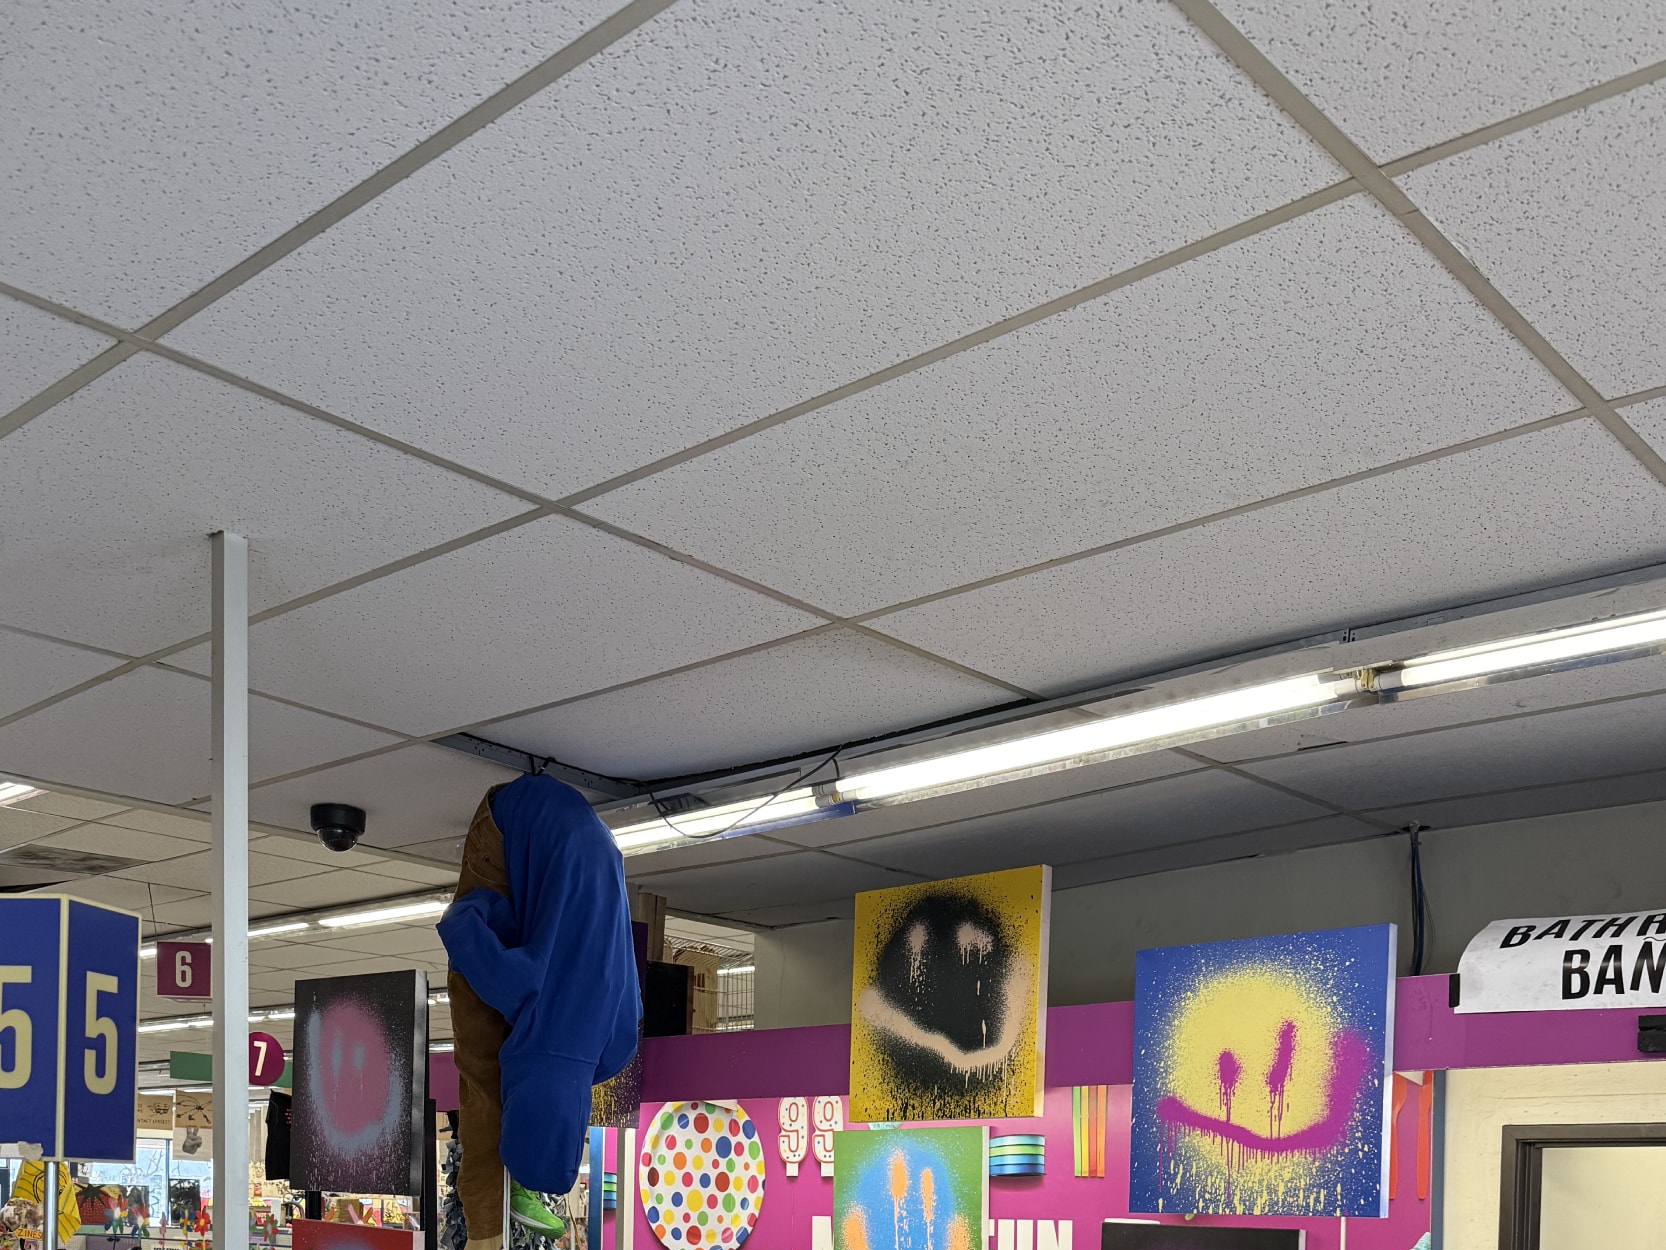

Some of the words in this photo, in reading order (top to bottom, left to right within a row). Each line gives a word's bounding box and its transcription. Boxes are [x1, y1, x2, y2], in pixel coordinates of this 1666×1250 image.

[175, 950, 193, 988] 6
[0, 965, 33, 1089] 5
[84, 970, 119, 1095] 5
[253, 1040, 268, 1077] 7
[17, 1229, 42, 1239] ZINES
